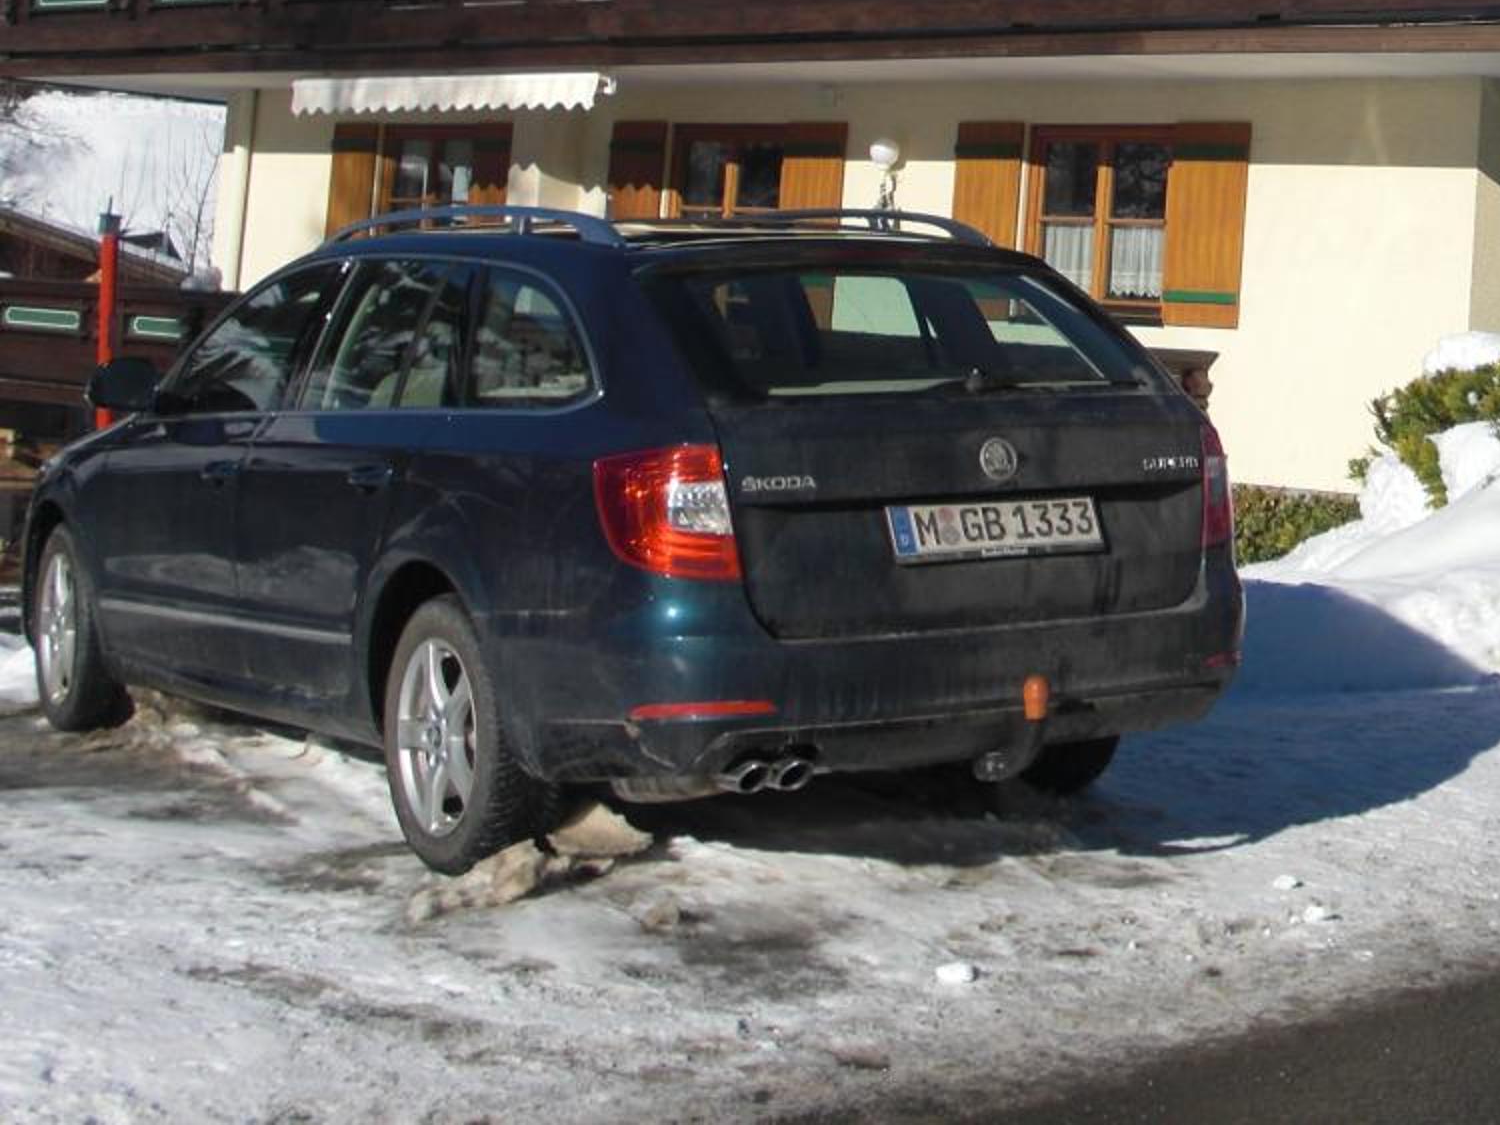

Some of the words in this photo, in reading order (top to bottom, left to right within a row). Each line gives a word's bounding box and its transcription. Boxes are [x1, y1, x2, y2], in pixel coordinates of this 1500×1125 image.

[913, 511, 941, 546] M
[960, 507, 1006, 542] GB
[1012, 501, 1093, 540] 1333
